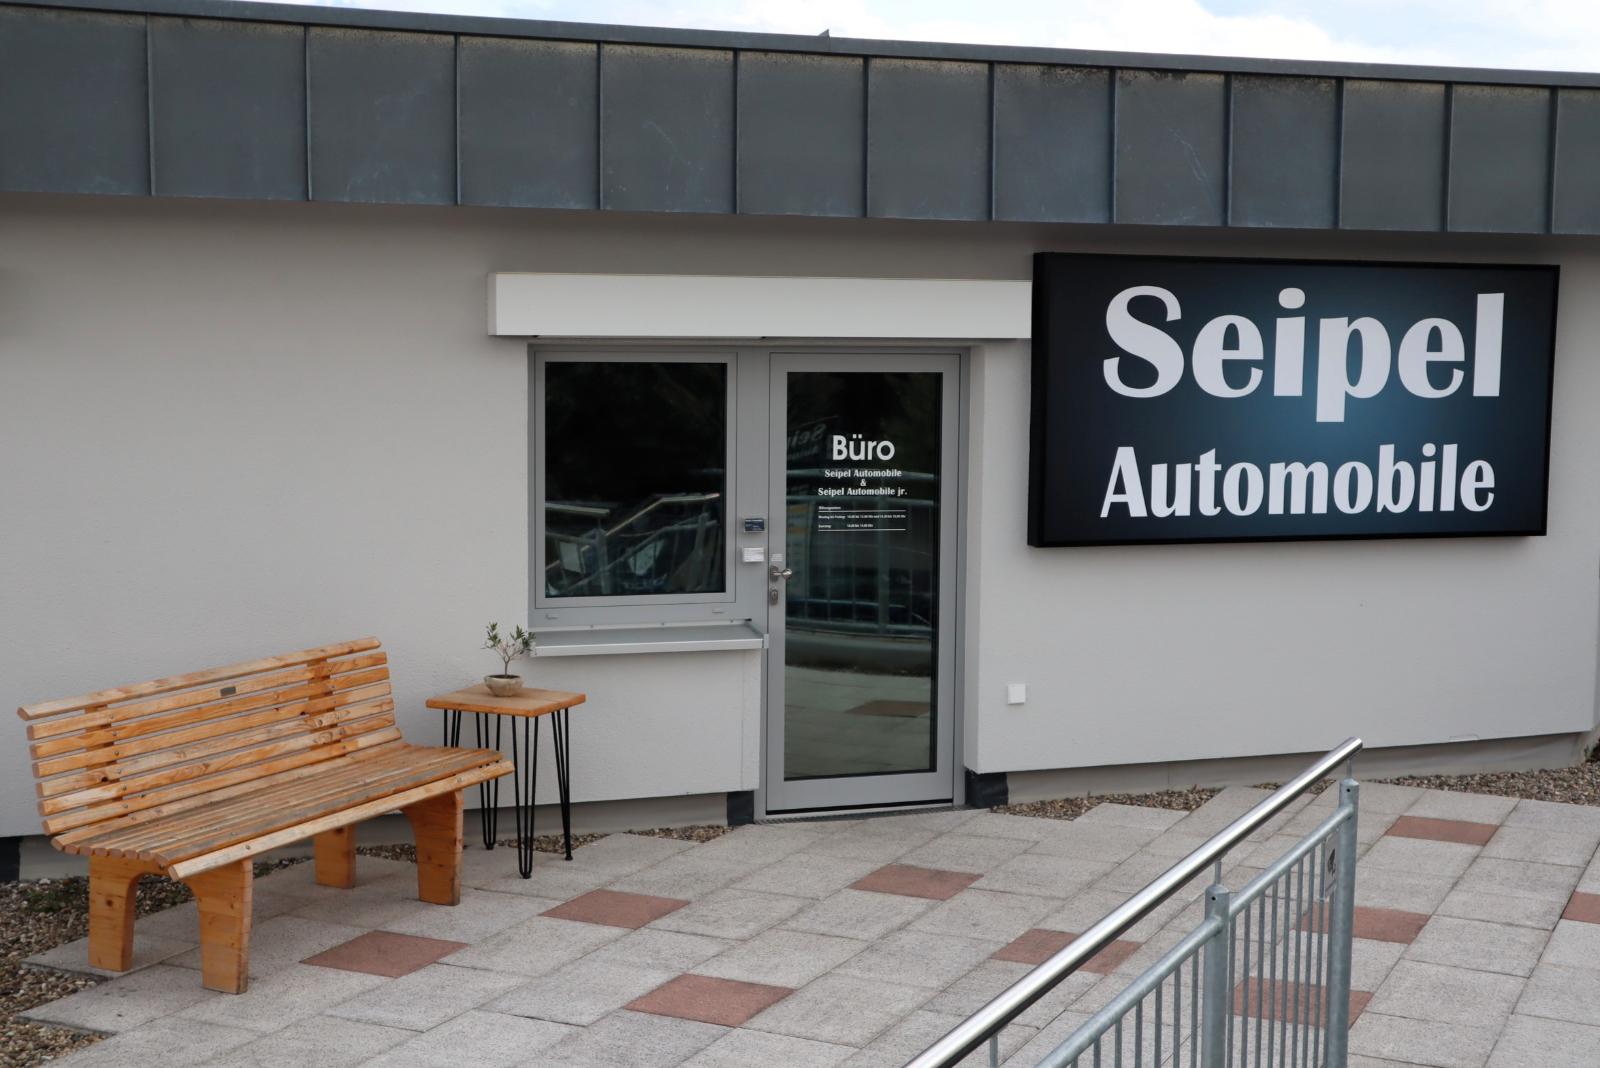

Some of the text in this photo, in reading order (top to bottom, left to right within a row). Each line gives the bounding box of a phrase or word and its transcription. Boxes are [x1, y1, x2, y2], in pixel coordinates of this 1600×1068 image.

[1102, 285, 1505, 423] Seipel
[832, 433, 896, 461] Büro
[824, 469, 902, 479] Seipel Automobile
[860, 478, 867, 487] &
[1100, 443, 1496, 518] Automobile
[818, 487, 908, 497] Seipel Automobile jr.
